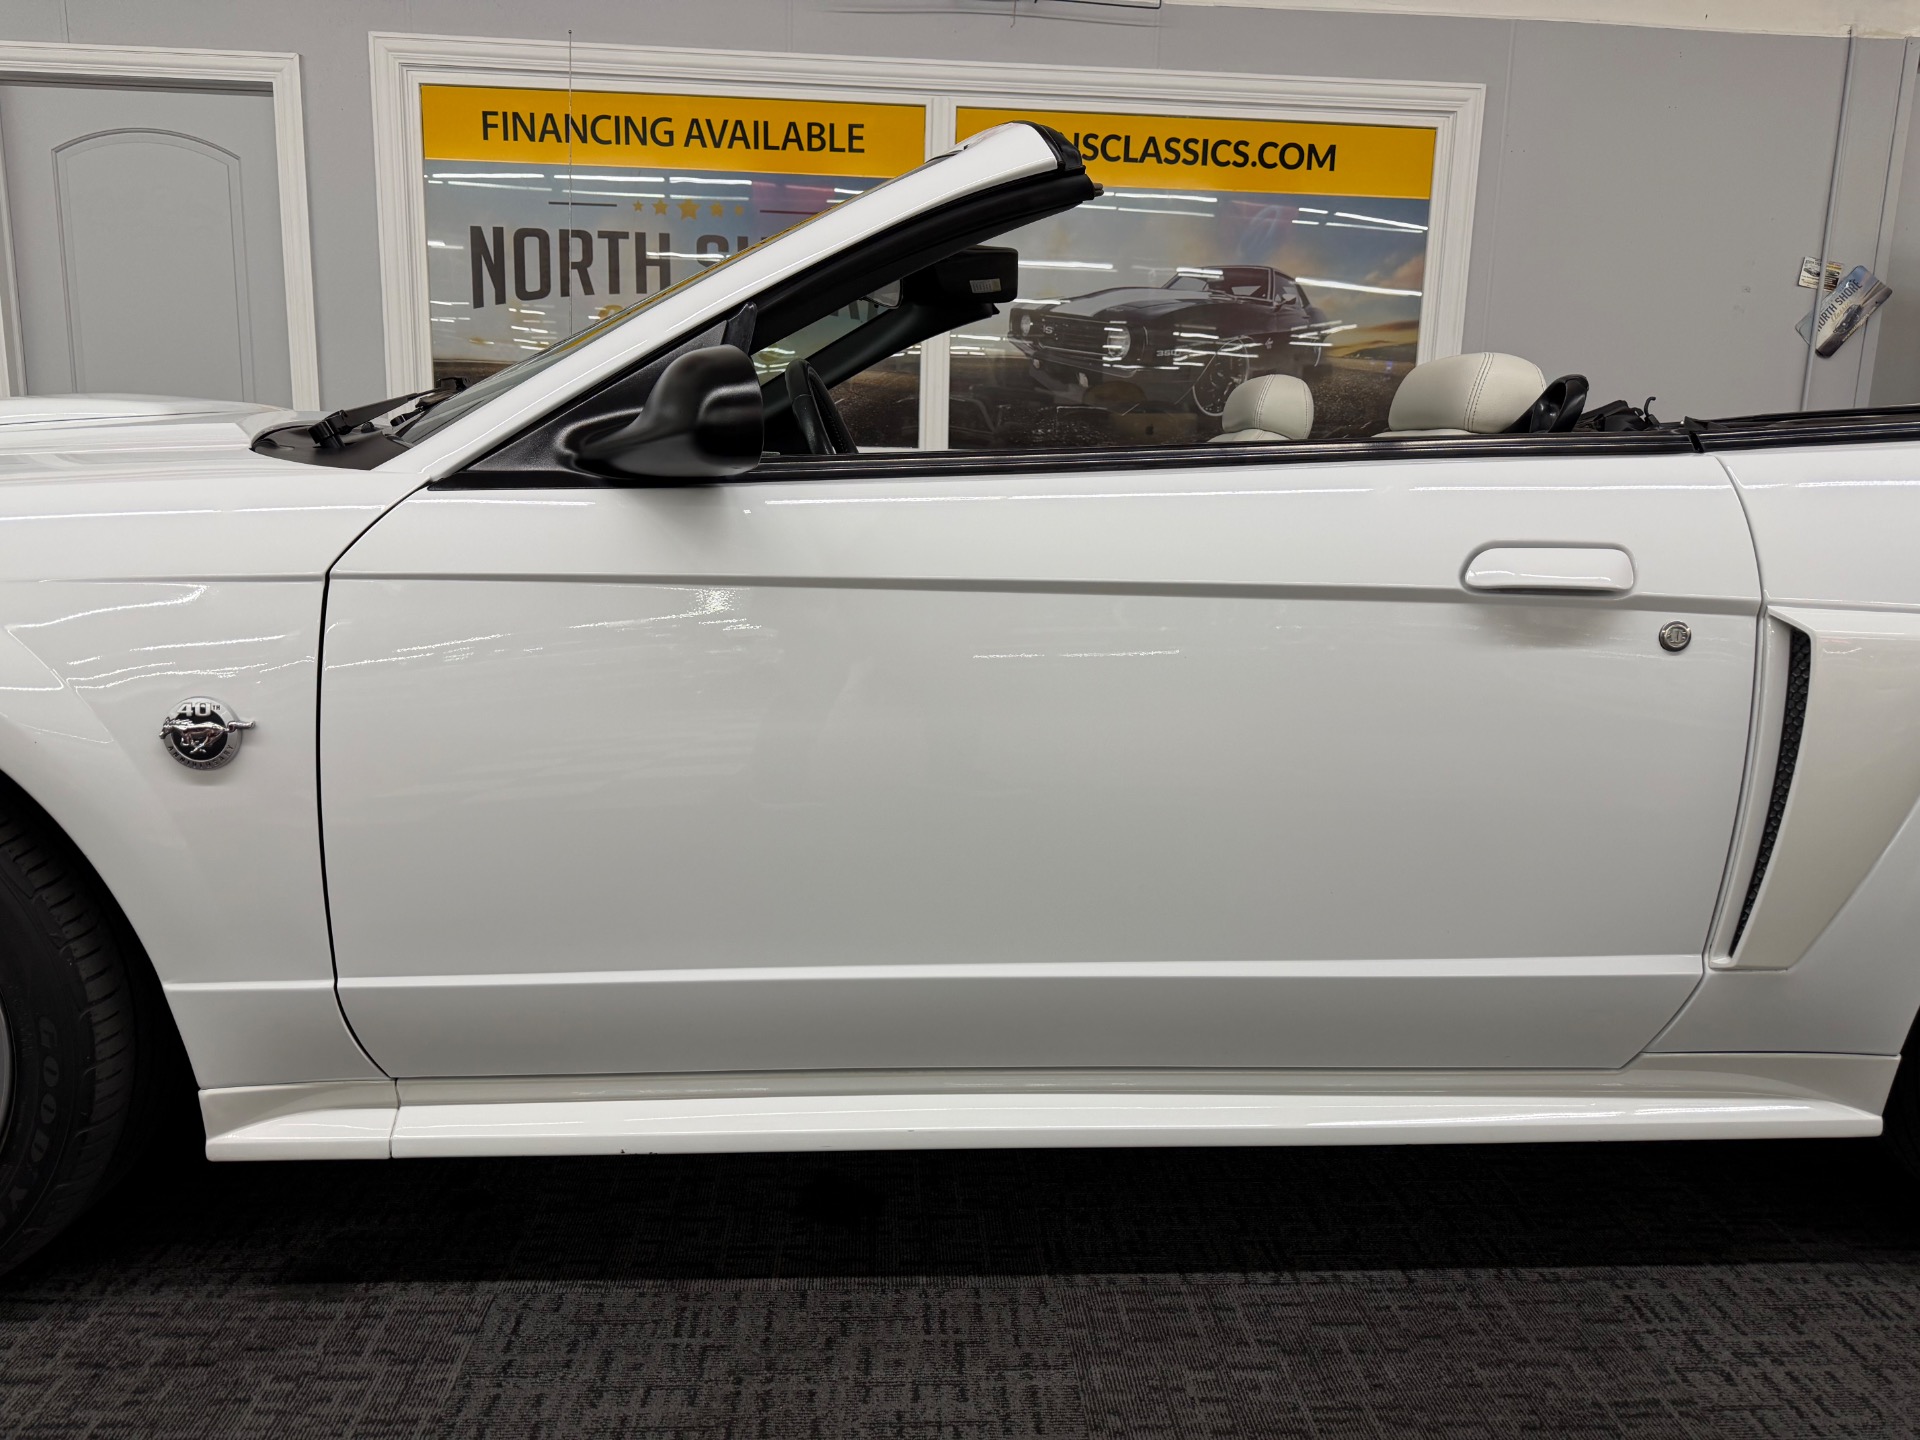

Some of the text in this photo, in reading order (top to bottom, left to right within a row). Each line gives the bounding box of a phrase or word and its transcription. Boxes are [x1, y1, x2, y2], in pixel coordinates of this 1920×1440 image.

[481, 110, 866, 154] FINANCING AVAILABLE
[469, 225, 672, 309] NORTH
